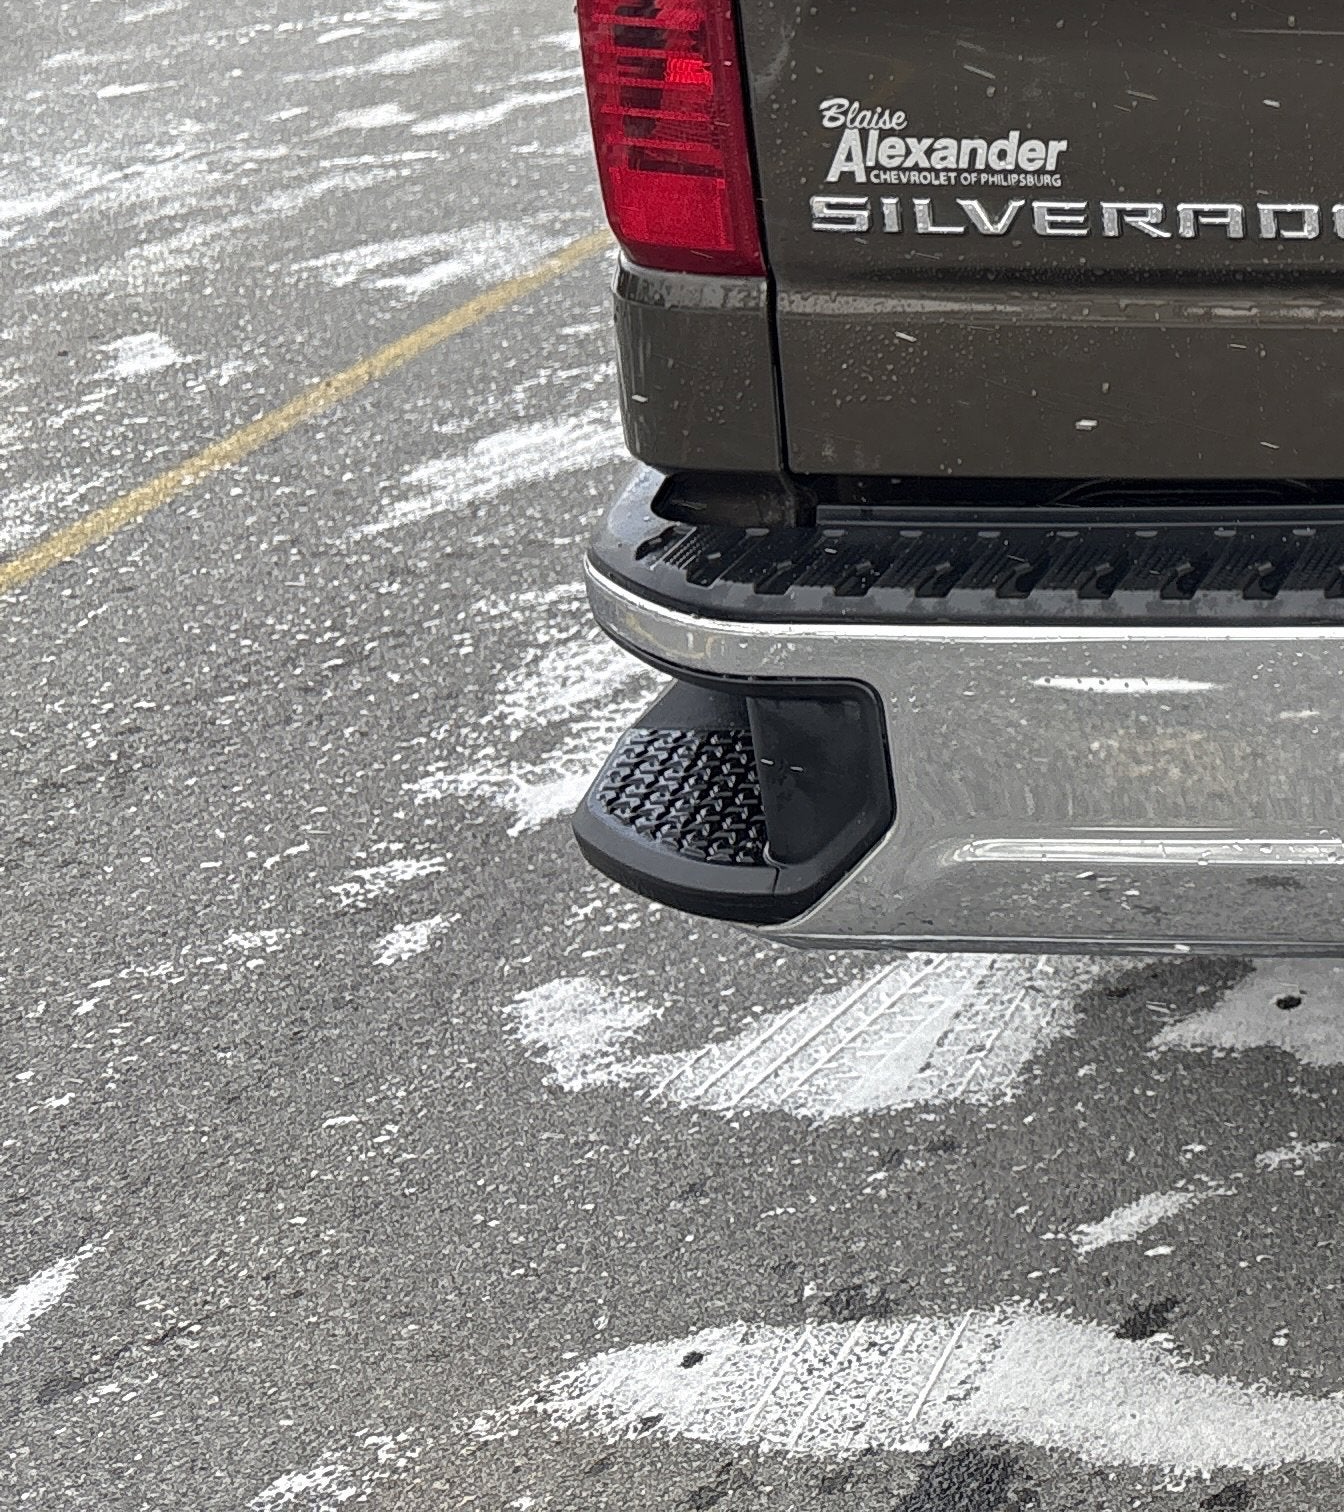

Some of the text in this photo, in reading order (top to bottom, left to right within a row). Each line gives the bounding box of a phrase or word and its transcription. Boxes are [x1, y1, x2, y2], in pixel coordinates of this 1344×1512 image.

[819, 97, 908, 130] Blaise
[825, 128, 1068, 183] Alexander
[870, 170, 1062, 187] CHEVROLET OF PHILIPSBURG
